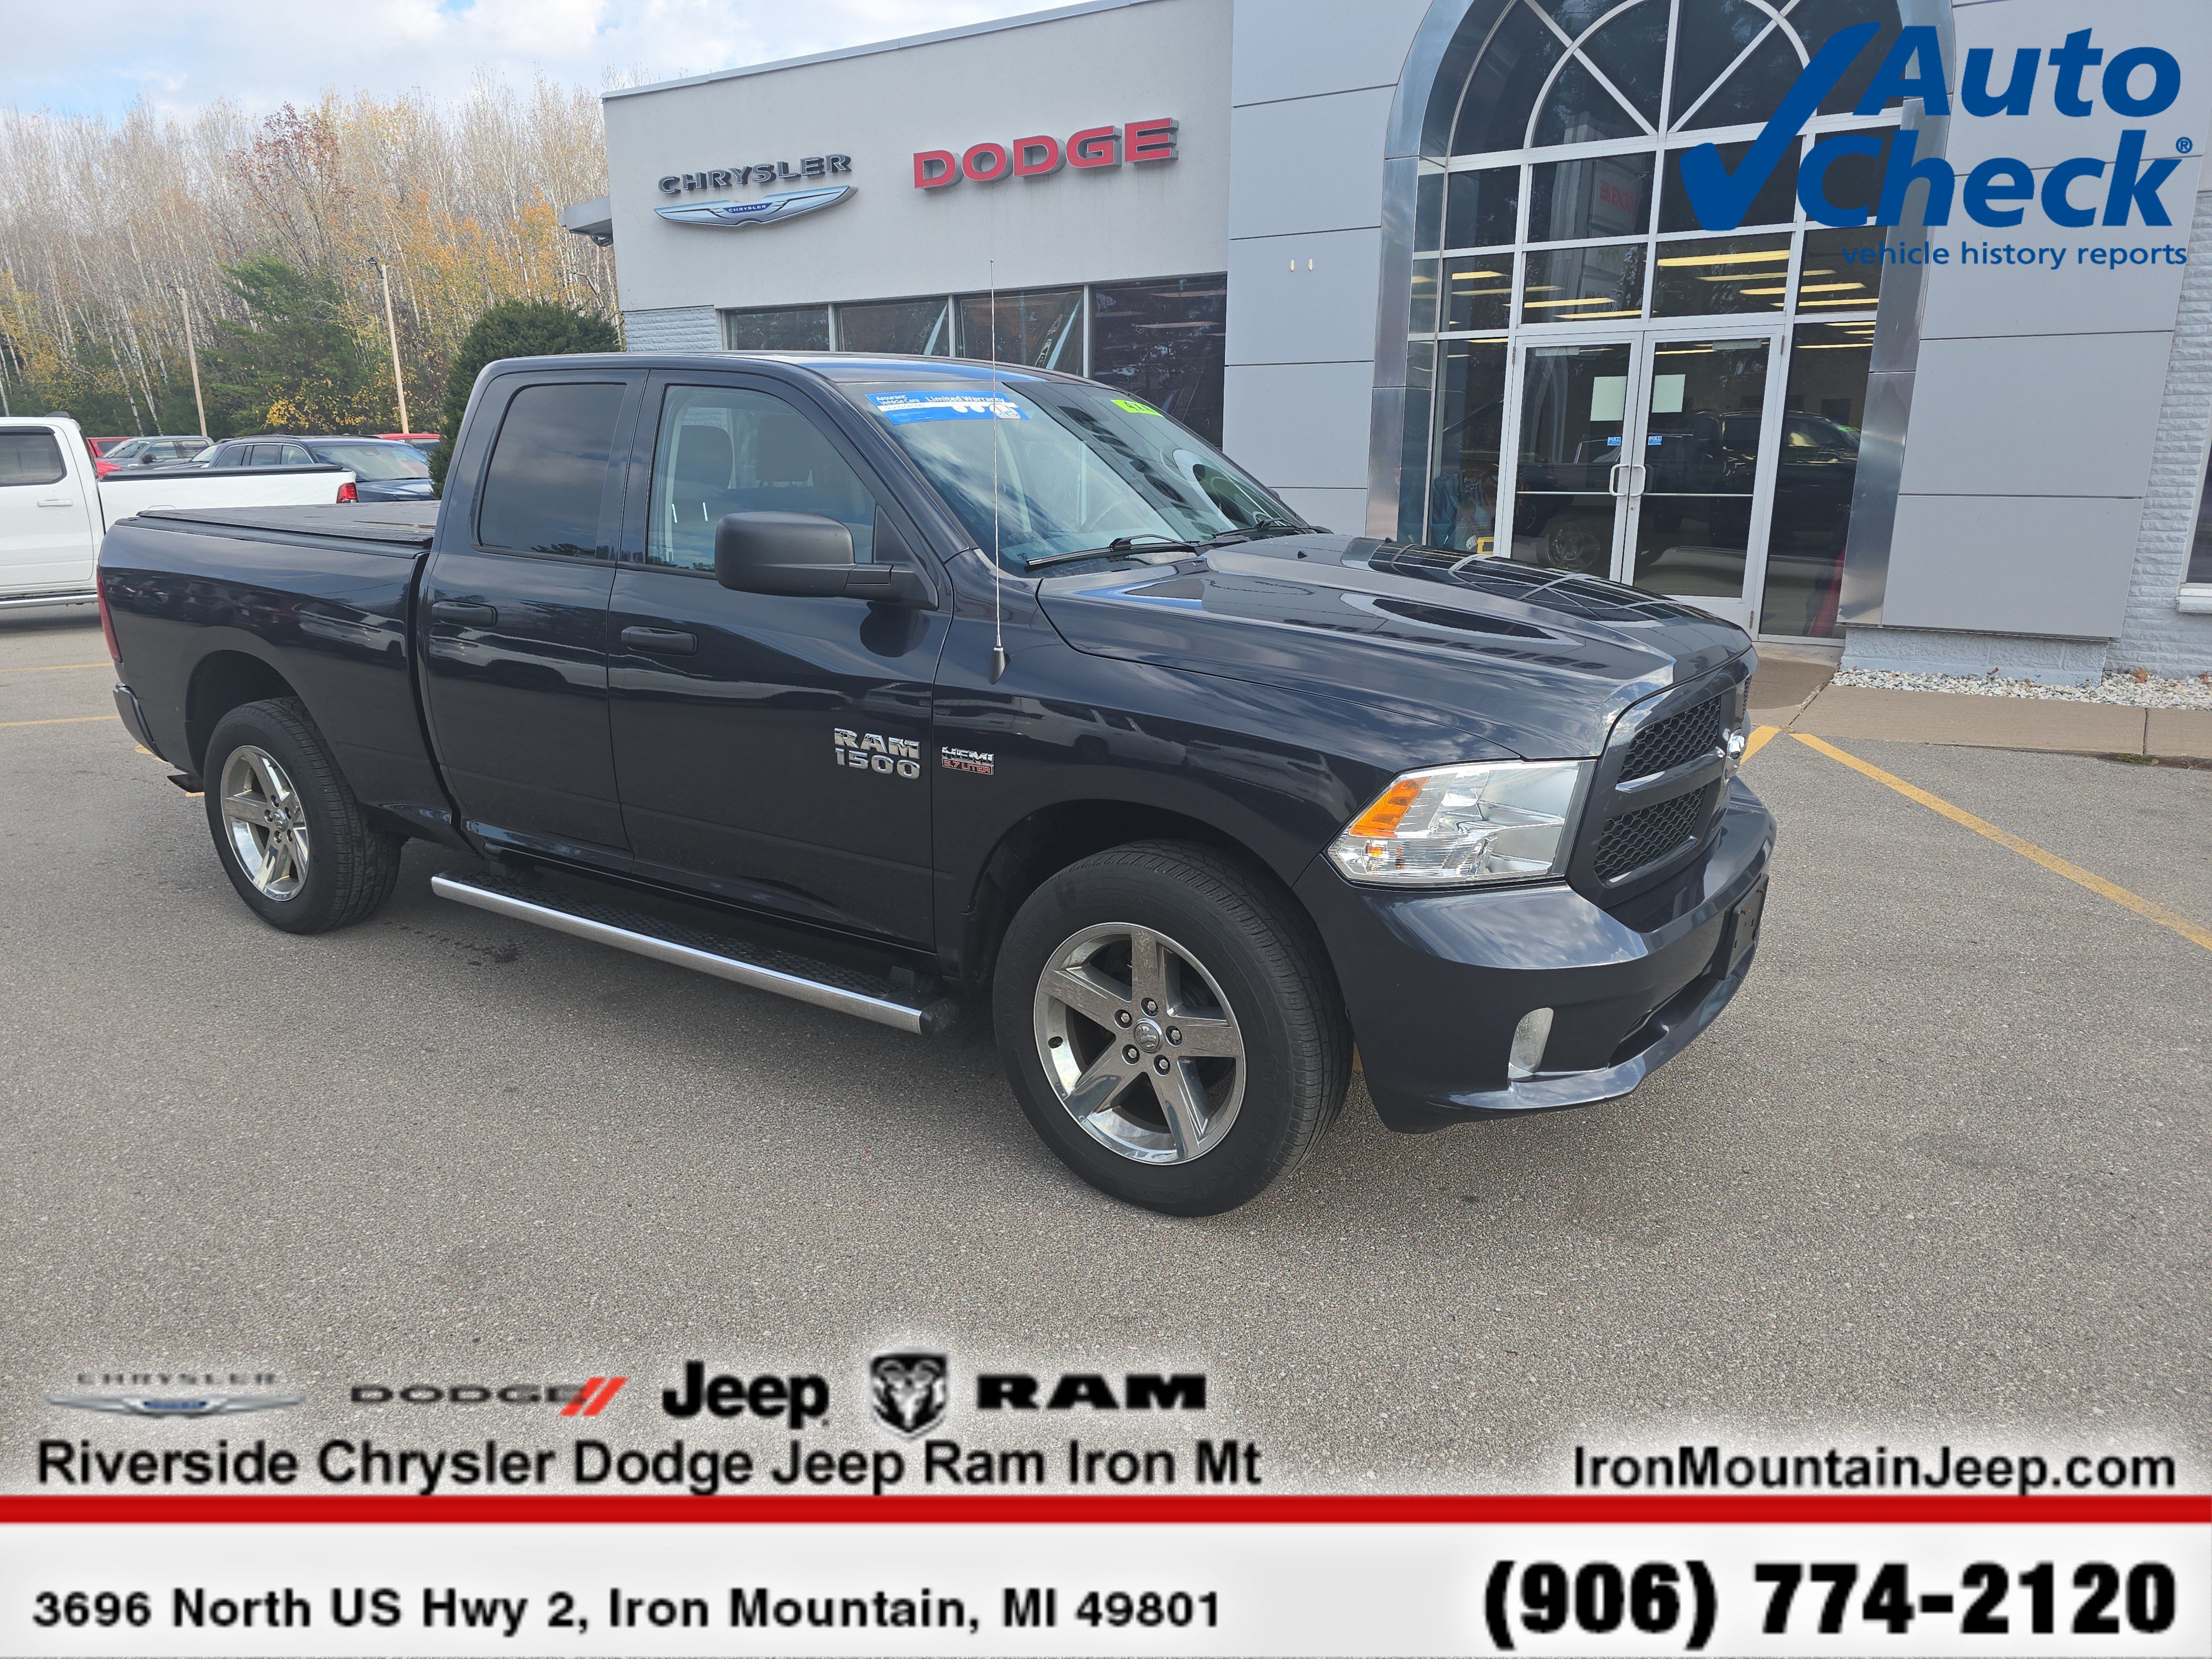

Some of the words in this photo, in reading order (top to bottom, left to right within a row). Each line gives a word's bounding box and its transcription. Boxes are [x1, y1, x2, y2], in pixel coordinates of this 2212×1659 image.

[914, 118, 1178, 190] DODGE
[658, 153, 851, 194] CHRYSLER
[728, 204, 767, 213] CHRYSLER
[834, 727, 920, 760] RAM
[942, 747, 994, 764] HEMI
[835, 748, 921, 779] 1500
[943, 760, 960, 769] 5.7
[961, 762, 991, 774] LITER
